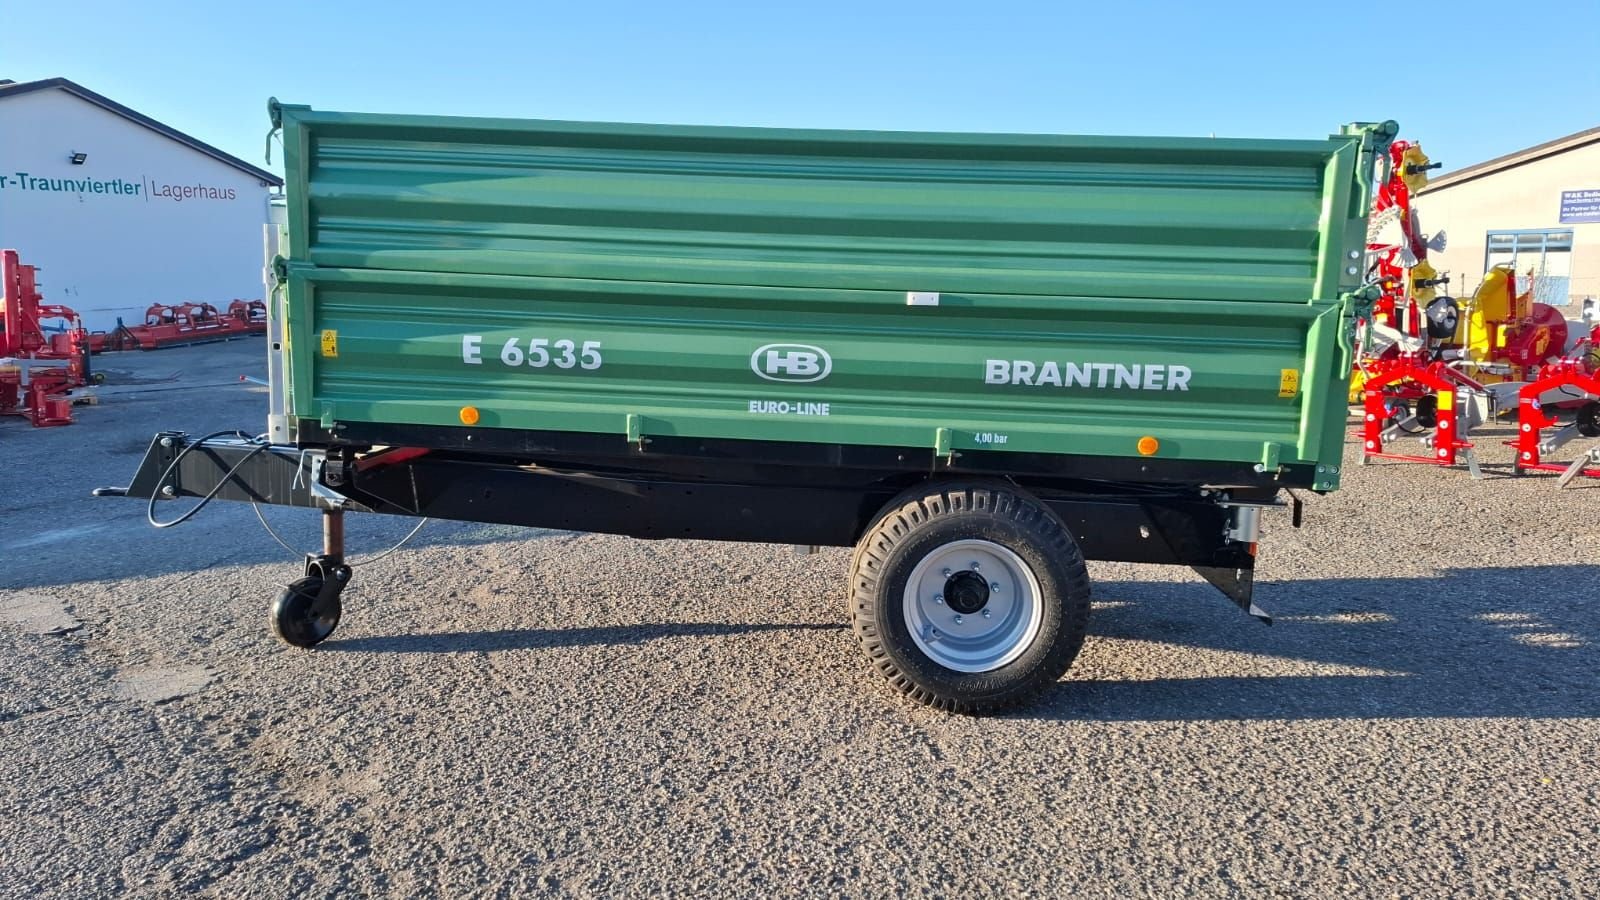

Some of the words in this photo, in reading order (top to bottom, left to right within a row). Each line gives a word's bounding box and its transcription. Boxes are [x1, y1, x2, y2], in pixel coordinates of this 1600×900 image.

[0, 172, 141, 195] r-Traunviertler
[152, 180, 236, 201] Lagerhaus
[462, 335, 482, 364] E
[501, 337, 602, 369] 6535
[766, 350, 820, 375] HB
[985, 359, 1192, 391] BRANTNER
[749, 400, 830, 416] EURO-LINE
[974, 432, 992, 445] 4,00
[994, 433, 1008, 444] bar
